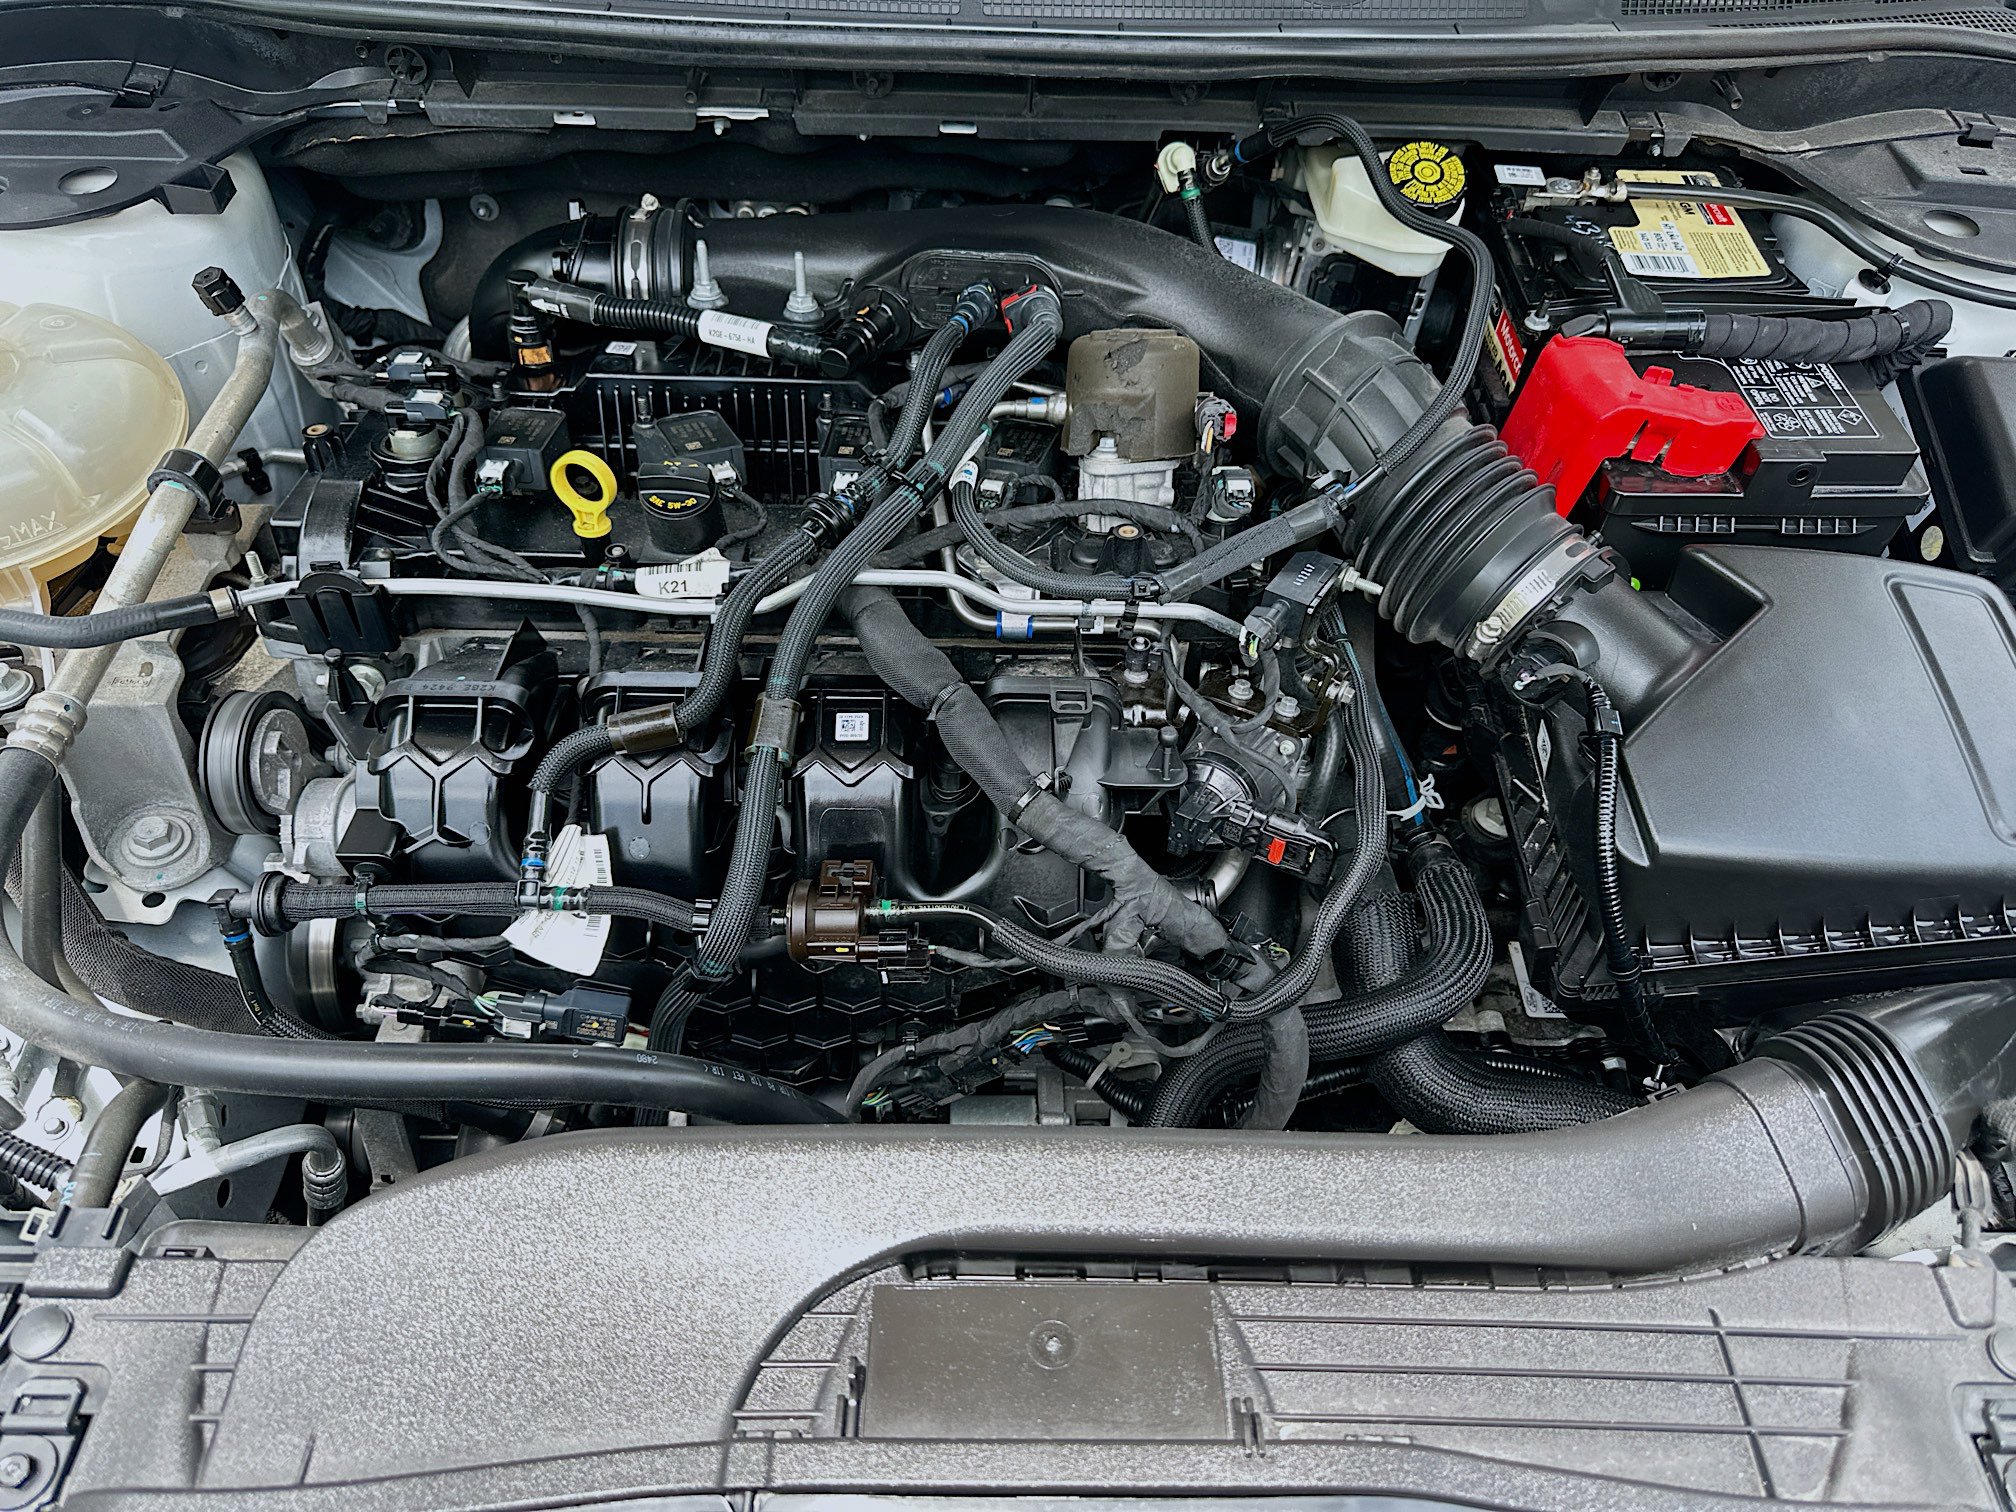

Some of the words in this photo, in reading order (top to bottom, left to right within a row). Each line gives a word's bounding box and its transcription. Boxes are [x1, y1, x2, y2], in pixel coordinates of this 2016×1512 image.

[649, 495, 665, 507] SAE
[667, 497, 697, 509] 5W-30
[10, 510, 64, 541] MAX
[659, 580, 687, 595] K21
